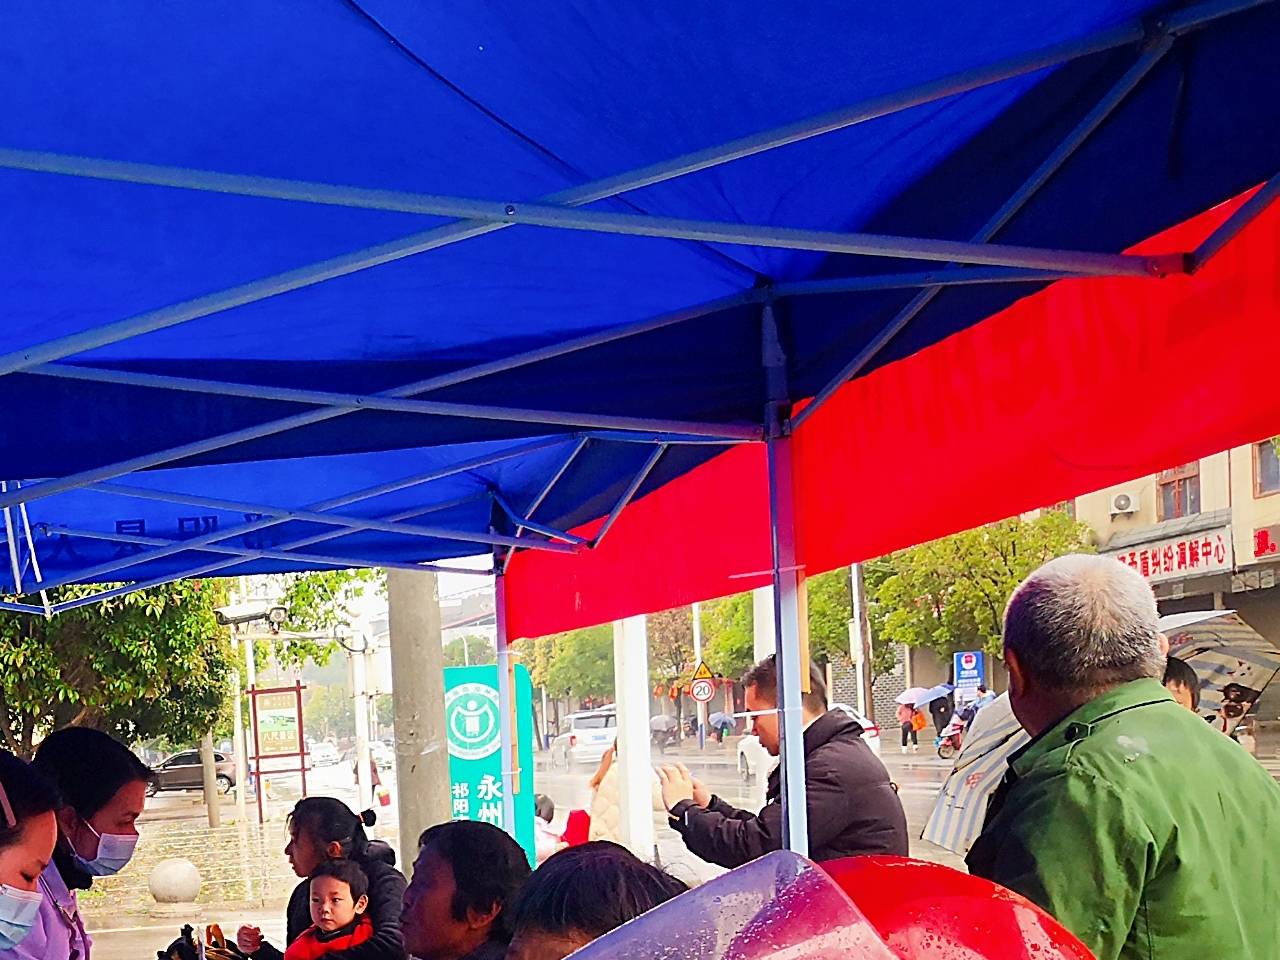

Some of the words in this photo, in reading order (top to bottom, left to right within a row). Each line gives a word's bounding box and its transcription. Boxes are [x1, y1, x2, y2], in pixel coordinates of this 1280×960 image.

[695, 685, 710, 696] 20
[452, 782, 470, 822] 祁阳
[476, 774, 503, 829] 永州
